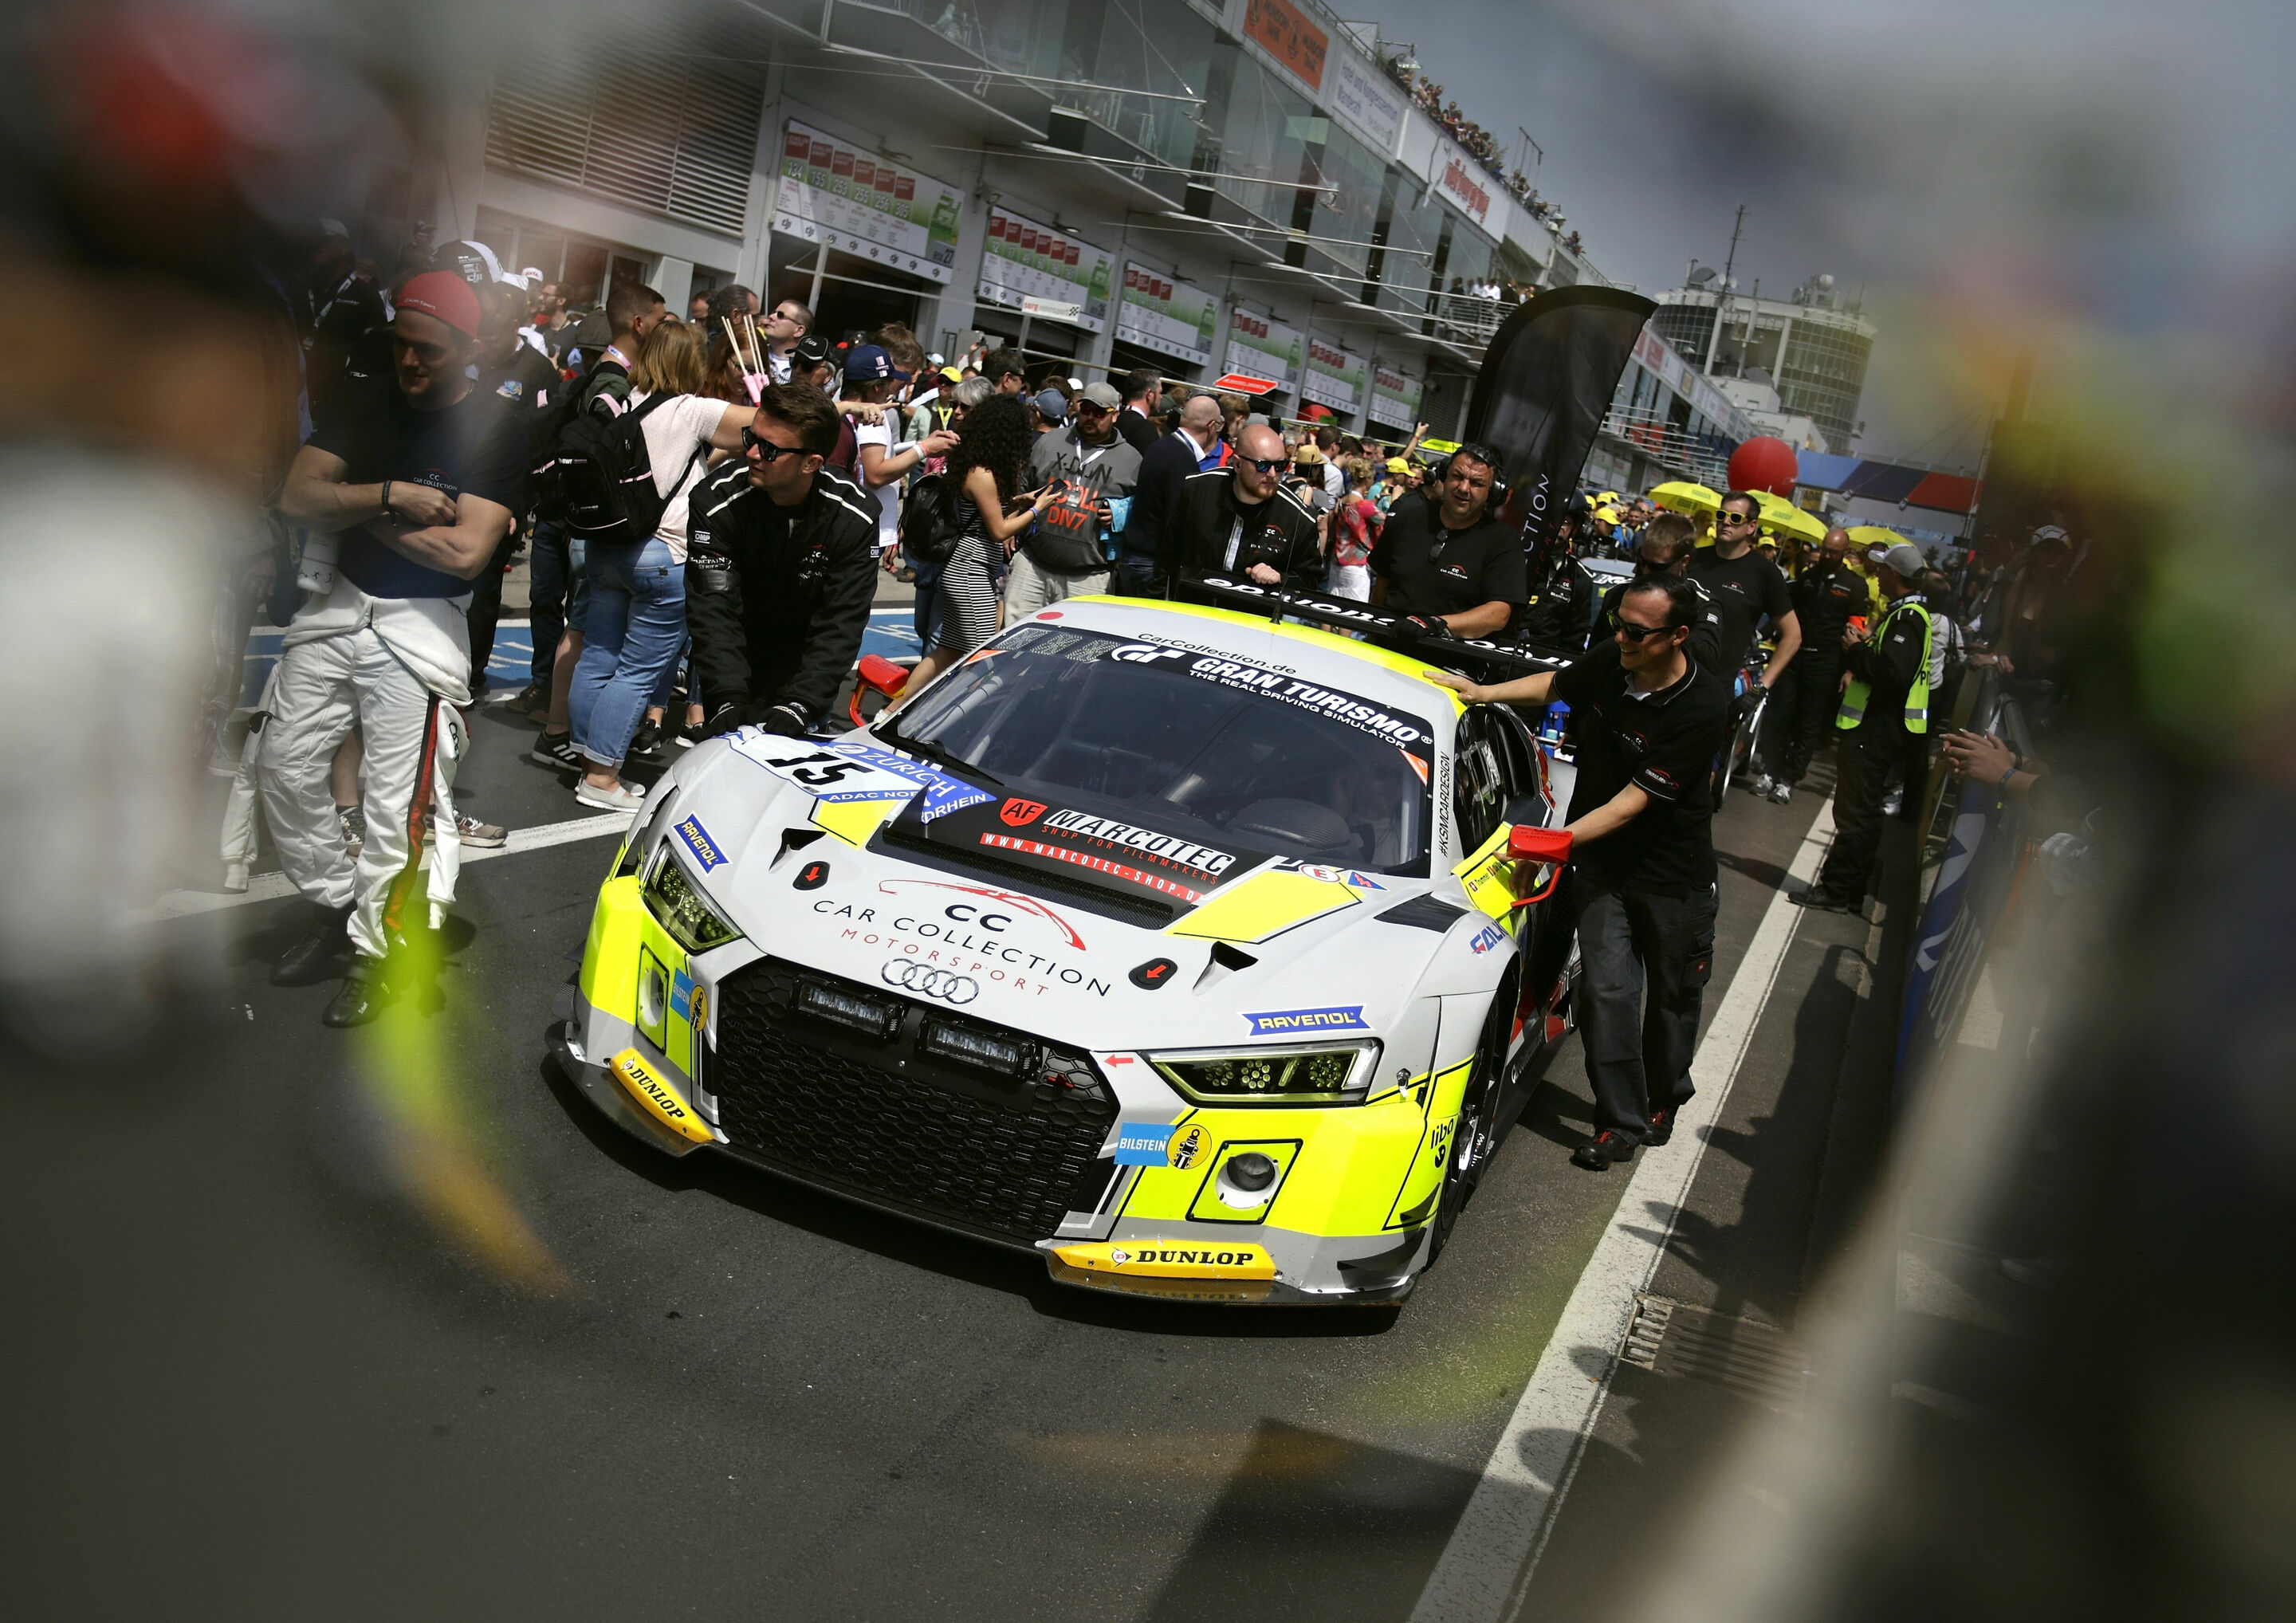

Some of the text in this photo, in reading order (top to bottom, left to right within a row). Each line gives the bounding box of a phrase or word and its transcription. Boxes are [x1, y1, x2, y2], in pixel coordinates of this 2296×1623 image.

[423, 479, 458, 491] COLLECTION
[1138, 633, 1297, 675] CarCollection.de
[1189, 670, 1406, 750] THE REAL DRIVING SIMULATOR
[1191, 658, 1421, 742] GRAN TURISMO
[828, 792, 879, 802] ADAC
[862, 752, 957, 798] ZURICH
[1003, 802, 1041, 820] AF
[1438, 751, 1450, 858] #KSMCARDESIGN
[681, 820, 719, 867] RAVENOL
[1041, 825, 1218, 886] SHOP FOR FILMMAKERS
[1048, 810, 1233, 874] MARCOTEC
[1313, 868, 1328, 879] E
[944, 904, 1013, 933] CC
[813, 900, 1112, 997] CAR COLLECTION
[841, 928, 1049, 997] MOTORSPORT
[673, 982, 690, 1004] BILSTEIN
[1259, 1011, 1356, 1031] RAVENOL
[629, 1067, 686, 1119] DUNLOP
[1119, 1137, 1167, 1152] BILSTEIN
[1136, 1249, 1254, 1266] DUNLOP
